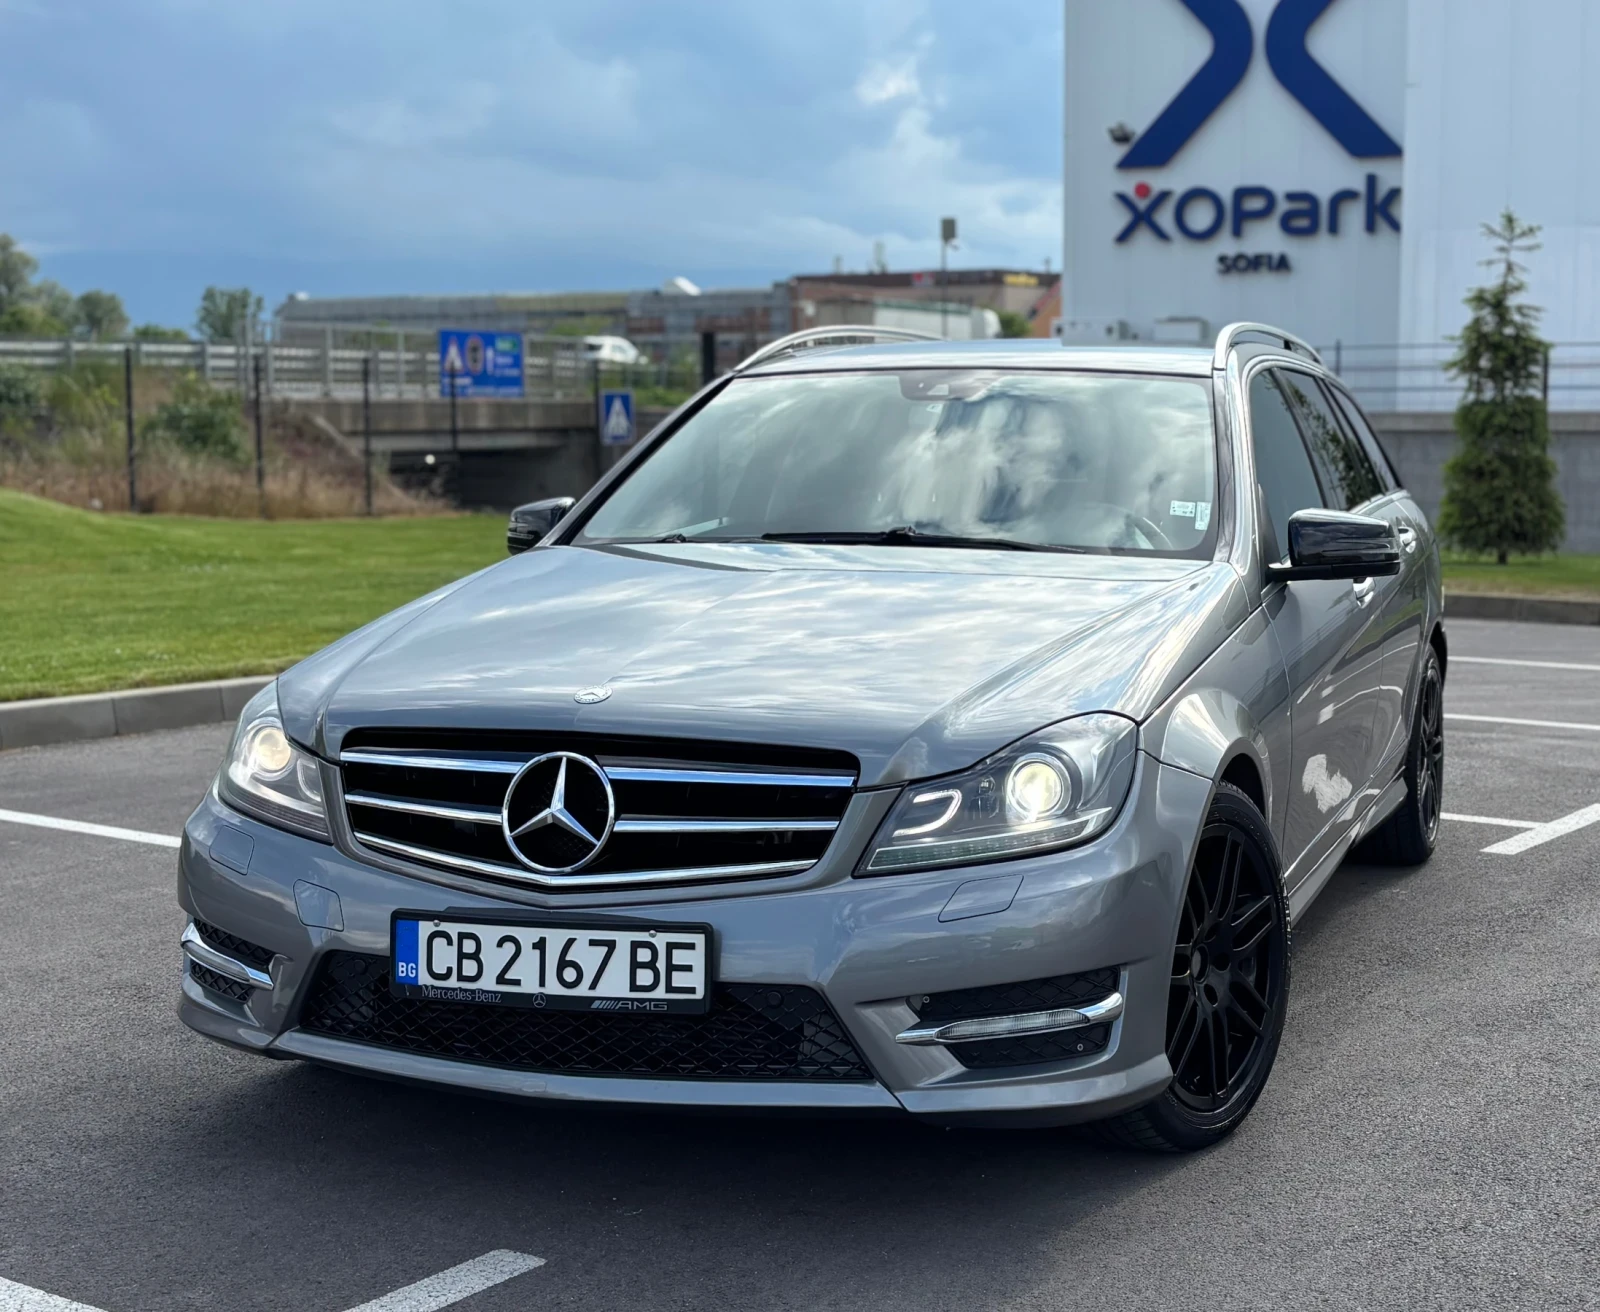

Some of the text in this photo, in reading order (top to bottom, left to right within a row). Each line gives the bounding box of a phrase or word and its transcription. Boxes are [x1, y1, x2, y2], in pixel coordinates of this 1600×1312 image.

[1217, 253, 1292, 275] SOFIA
[398, 962, 416, 978] BG
[426, 930, 697, 994] CB 2167 BE
[421, 984, 502, 1003] Mercedes-Benz
